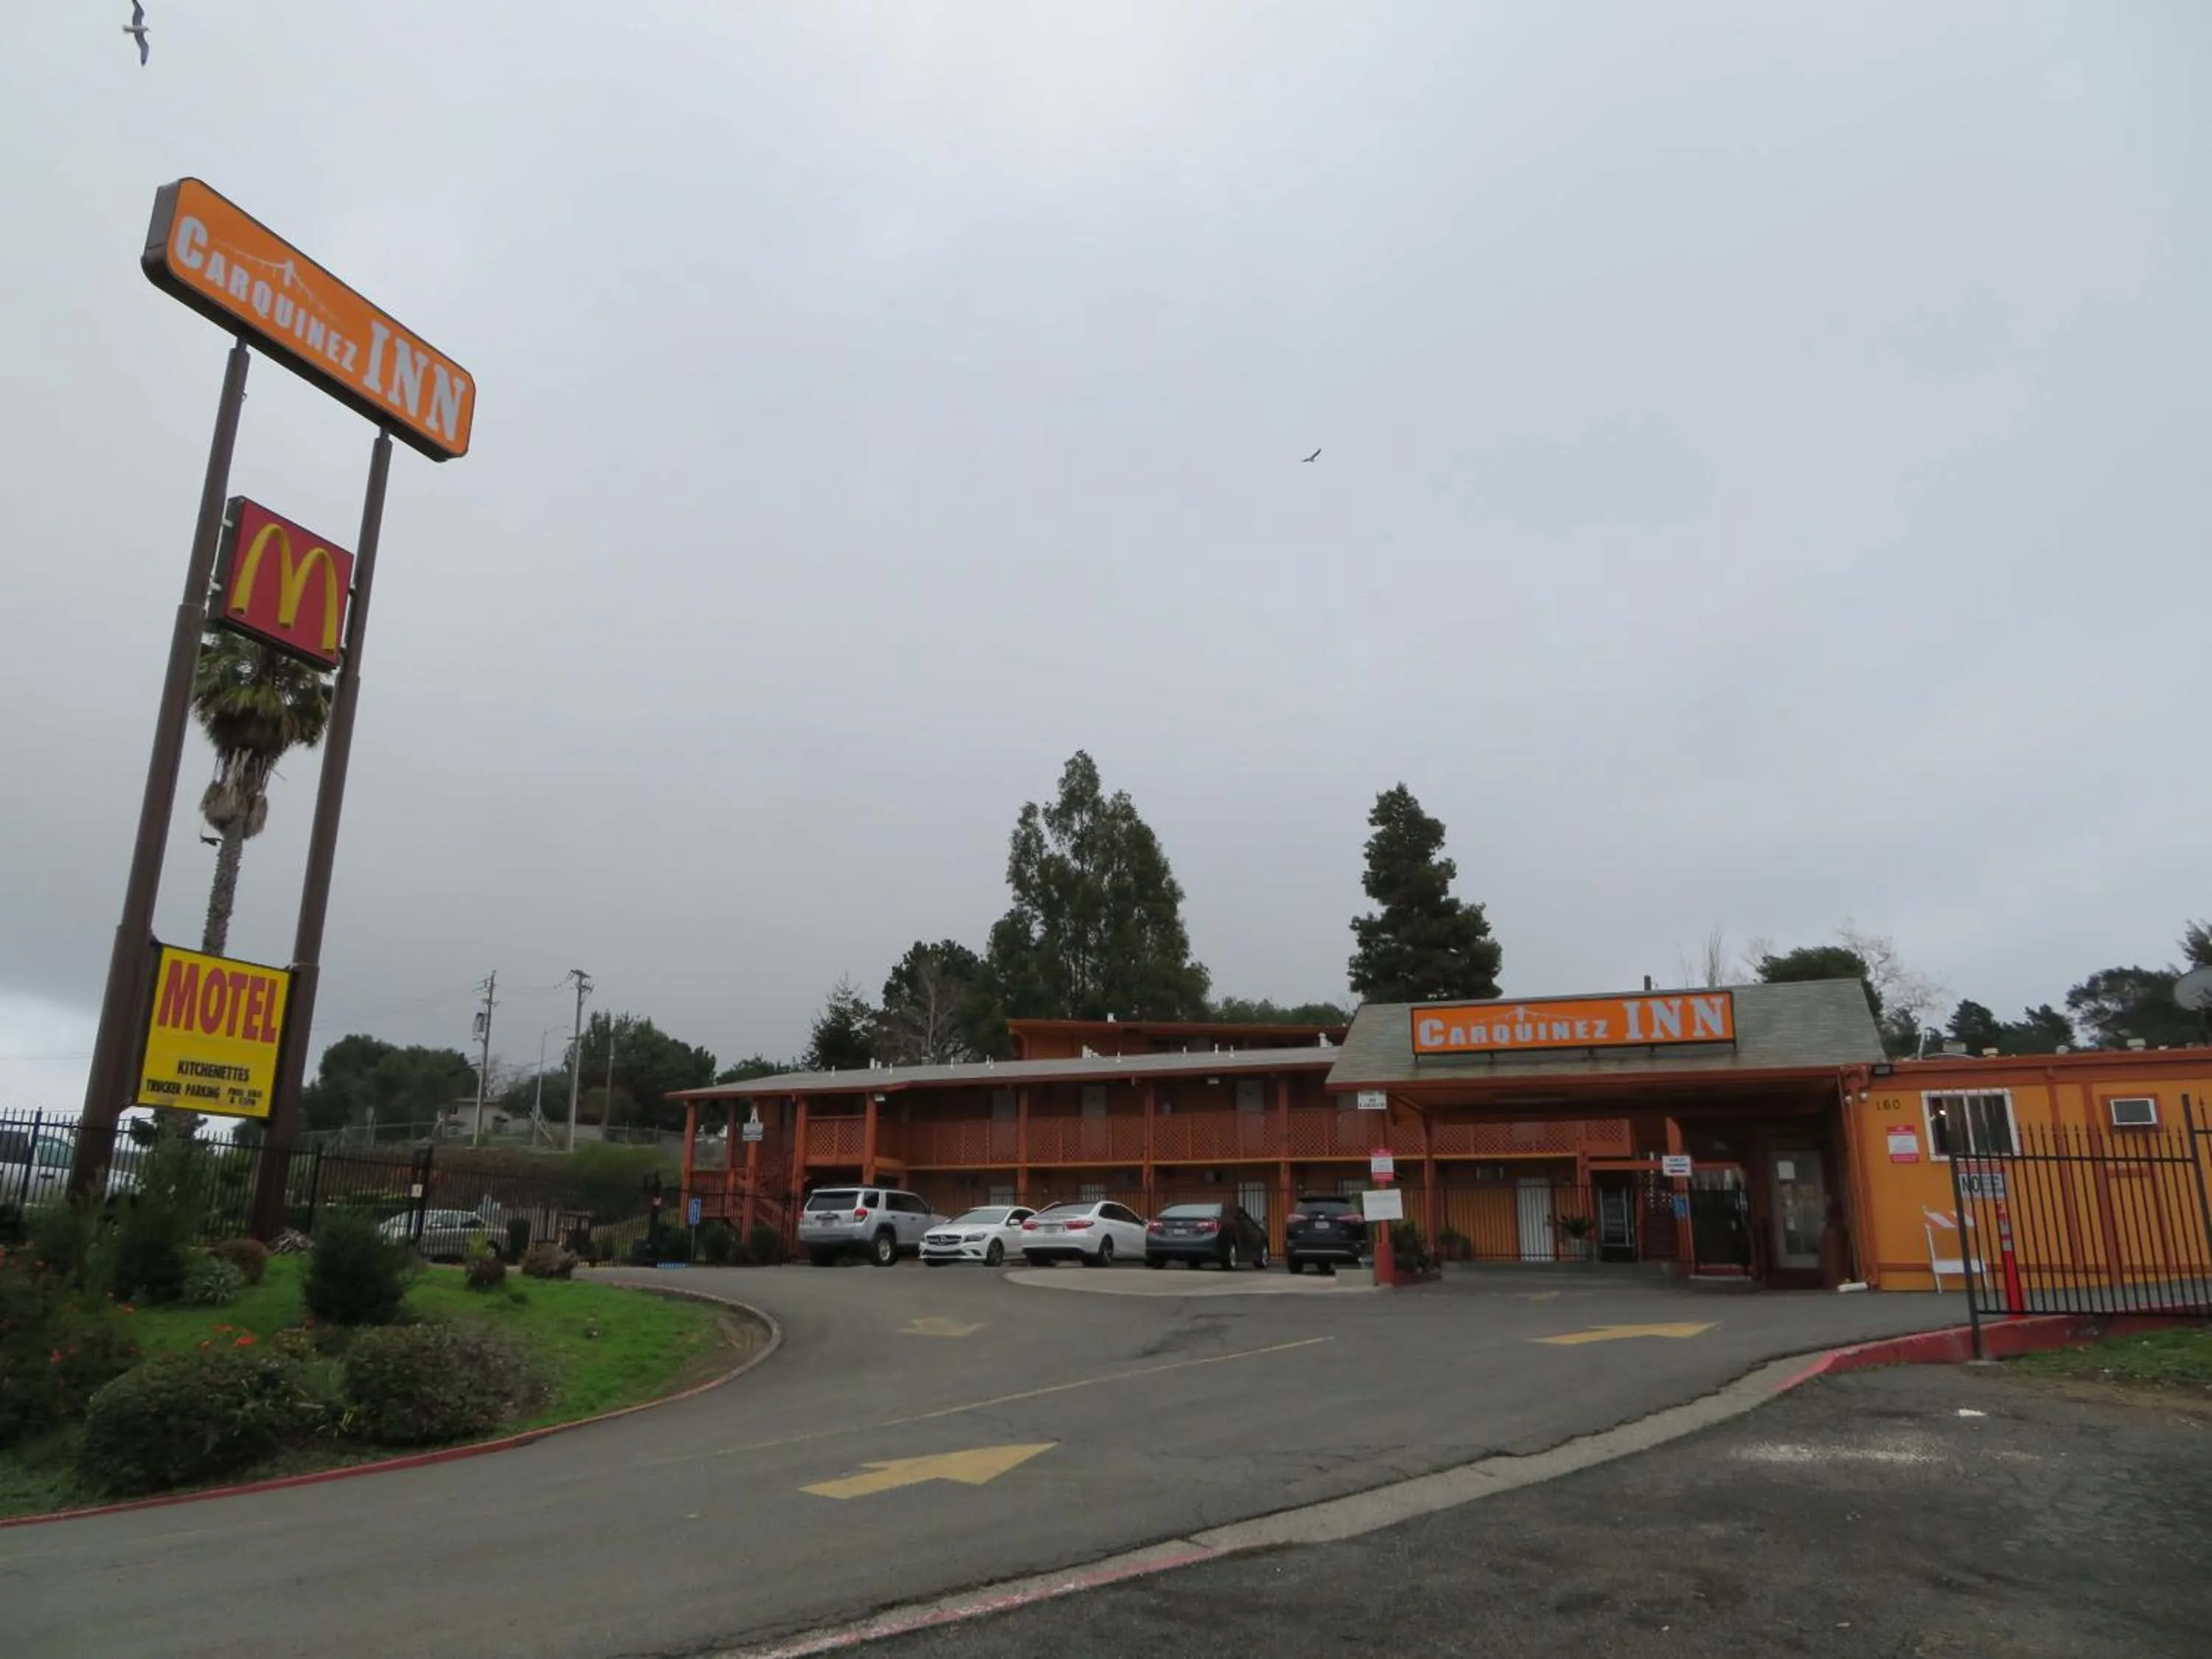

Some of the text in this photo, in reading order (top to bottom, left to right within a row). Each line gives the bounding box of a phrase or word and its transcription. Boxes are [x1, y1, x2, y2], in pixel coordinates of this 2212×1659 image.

[174, 215, 467, 442] CARQUINEZ INN
[157, 960, 278, 1044] MOTEL
[1418, 997, 1725, 1047] CARQUINEZ INN
[177, 1060, 250, 1082] KITCHENETTES
[184, 1083, 220, 1099] PARKING
[1876, 1099, 1901, 1112] 160
